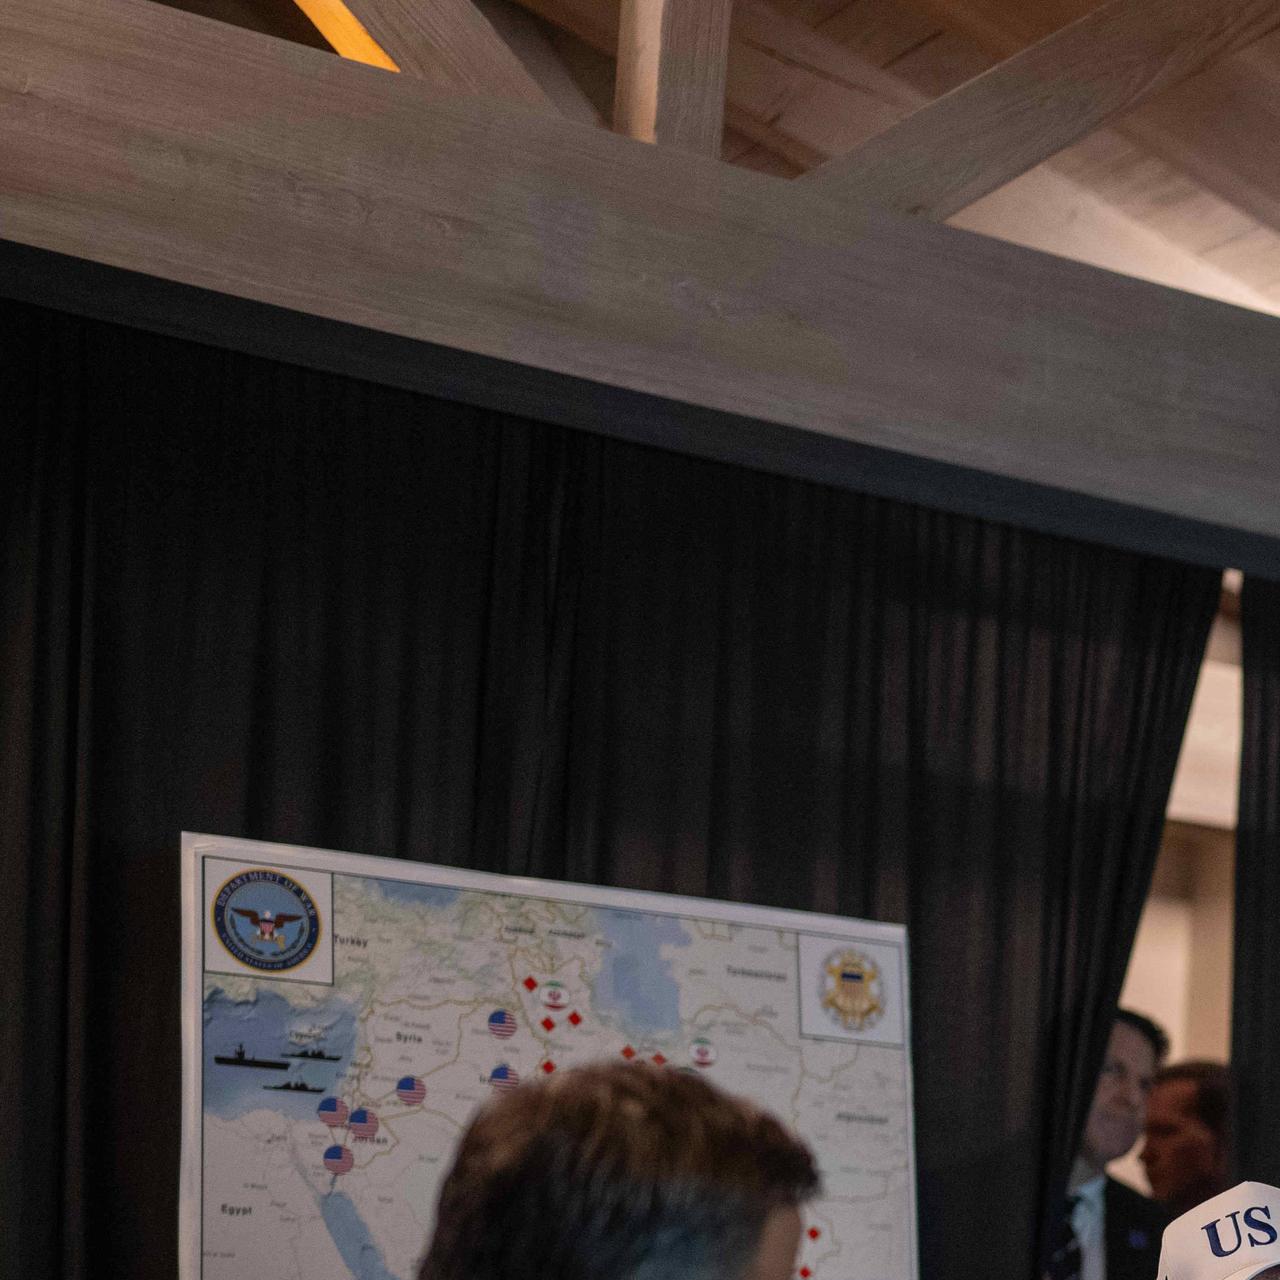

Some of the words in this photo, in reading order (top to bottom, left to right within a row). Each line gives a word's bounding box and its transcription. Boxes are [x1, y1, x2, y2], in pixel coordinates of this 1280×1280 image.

[217, 871, 281, 907] DEPARTMENT
[333, 933, 369, 949] Turkey
[395, 1031, 423, 1044] Syria
[220, 1203, 253, 1217] Egypt
